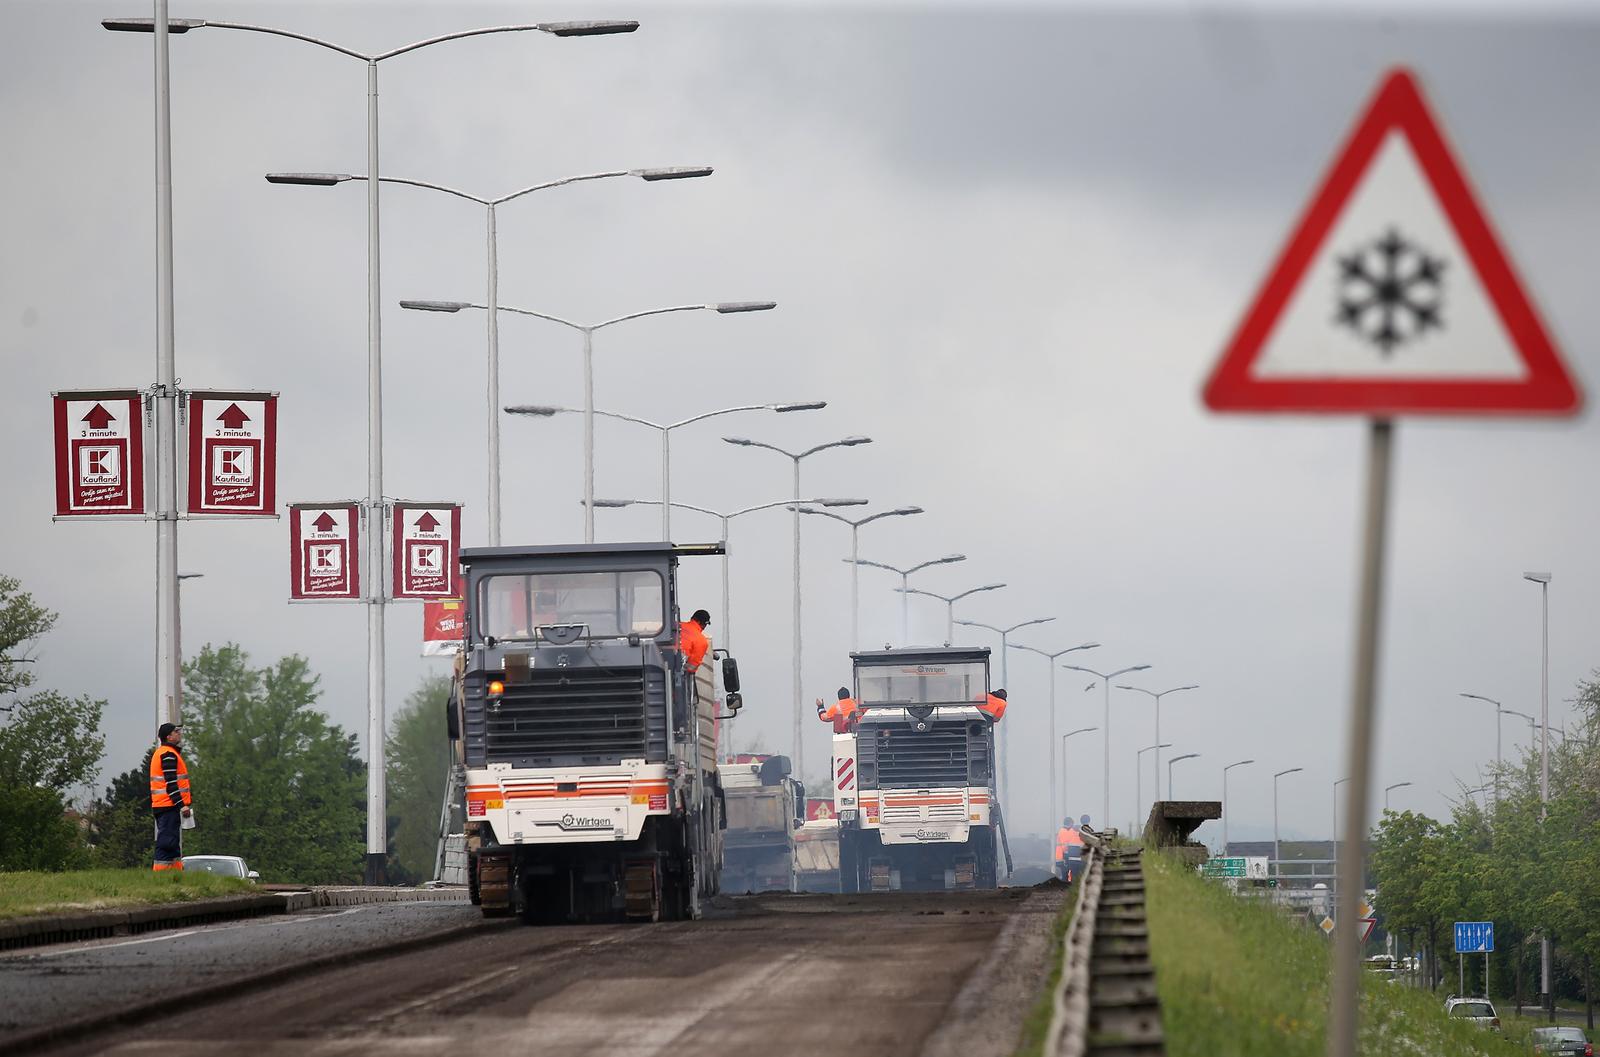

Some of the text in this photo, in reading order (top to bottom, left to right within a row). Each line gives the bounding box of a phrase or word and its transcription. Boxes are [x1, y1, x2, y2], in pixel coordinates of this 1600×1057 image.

[215, 429, 221, 437] 3
[215, 475, 250, 483] Kaufland
[576, 817, 611, 827] Wirtgen
[925, 831, 949, 839] Wirtgen
